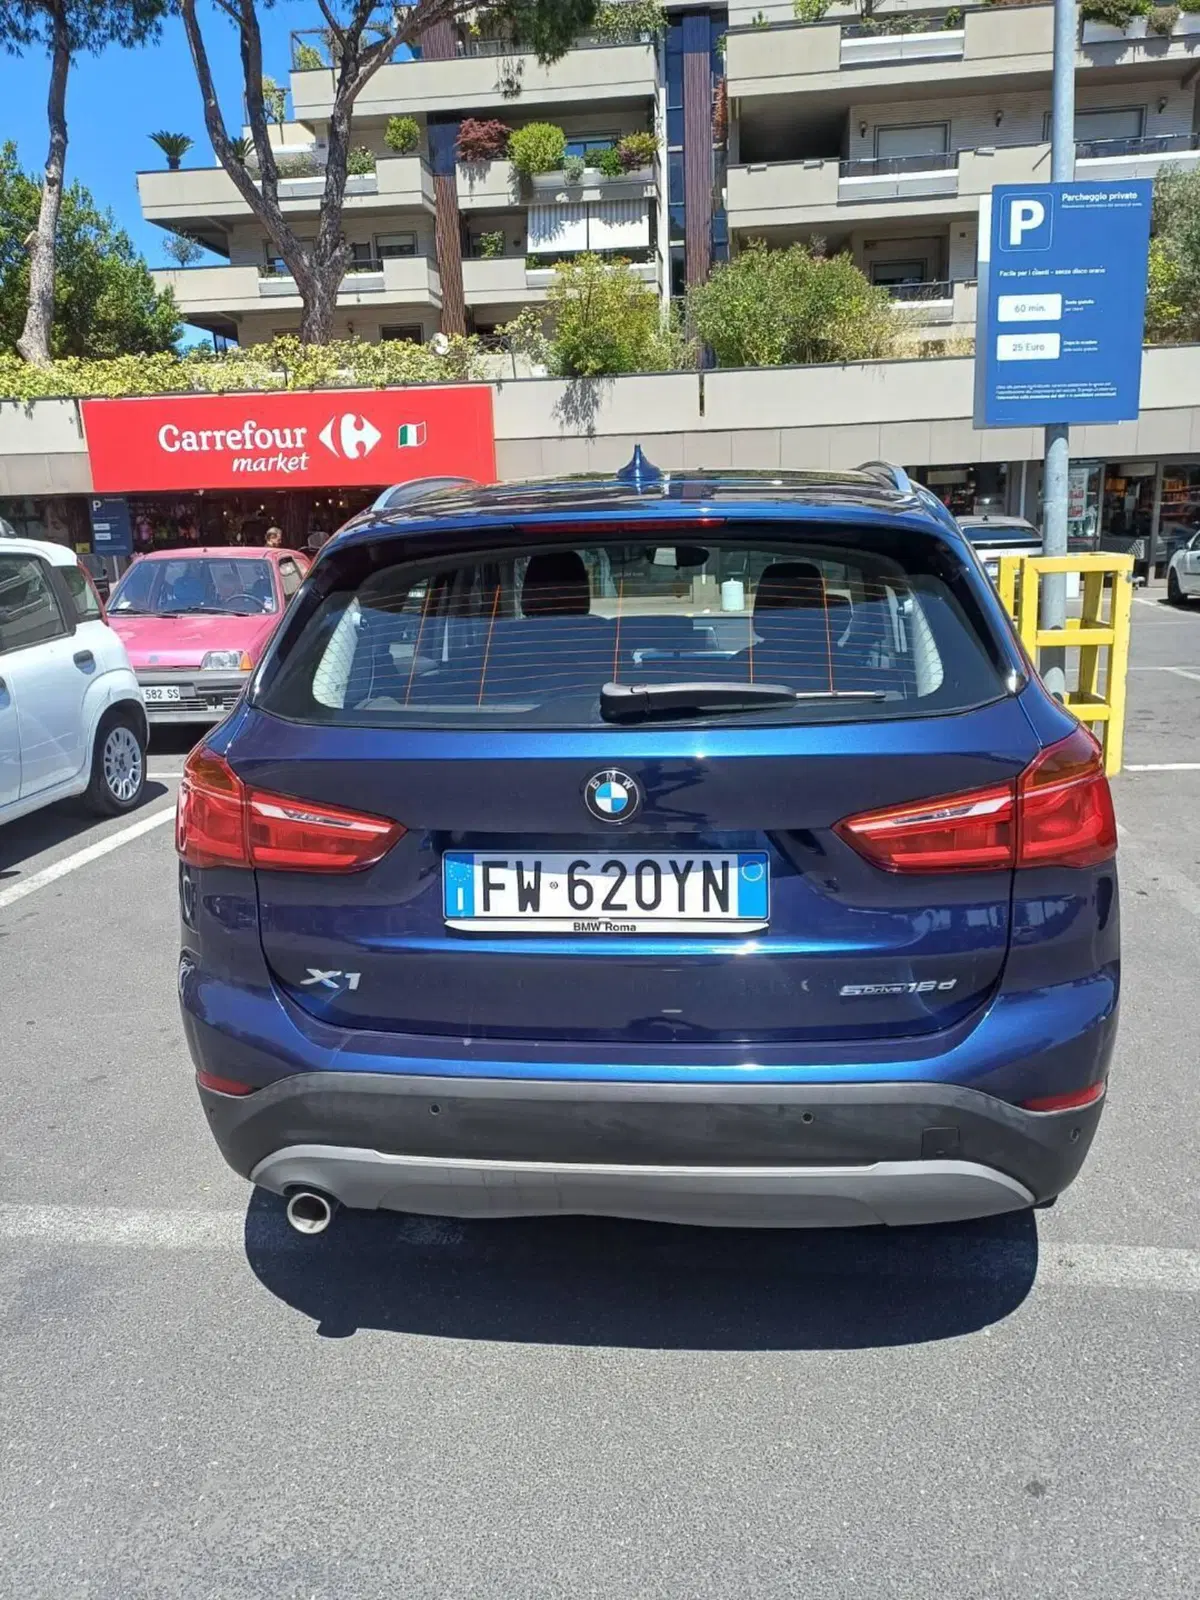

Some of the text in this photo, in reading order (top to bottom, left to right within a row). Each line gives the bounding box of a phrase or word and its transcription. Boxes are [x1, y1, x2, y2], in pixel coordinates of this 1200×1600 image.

[1061, 191, 1138, 203] Parcheggio privato
[1010, 199, 1045, 246] P
[1014, 303, 1026, 314] 60
[1012, 342, 1045, 352] 25 Euro
[157, 420, 308, 452] Carrefour
[231, 452, 310, 473] market
[92, 500, 102, 512] P
[145, 688, 179, 700] 582 SS
[590, 772, 634, 790] BMW
[481, 860, 542, 912] FW
[566, 859, 730, 913] 620YN
[573, 922, 637, 932] BMW Roma
[299, 968, 362, 990] X1
